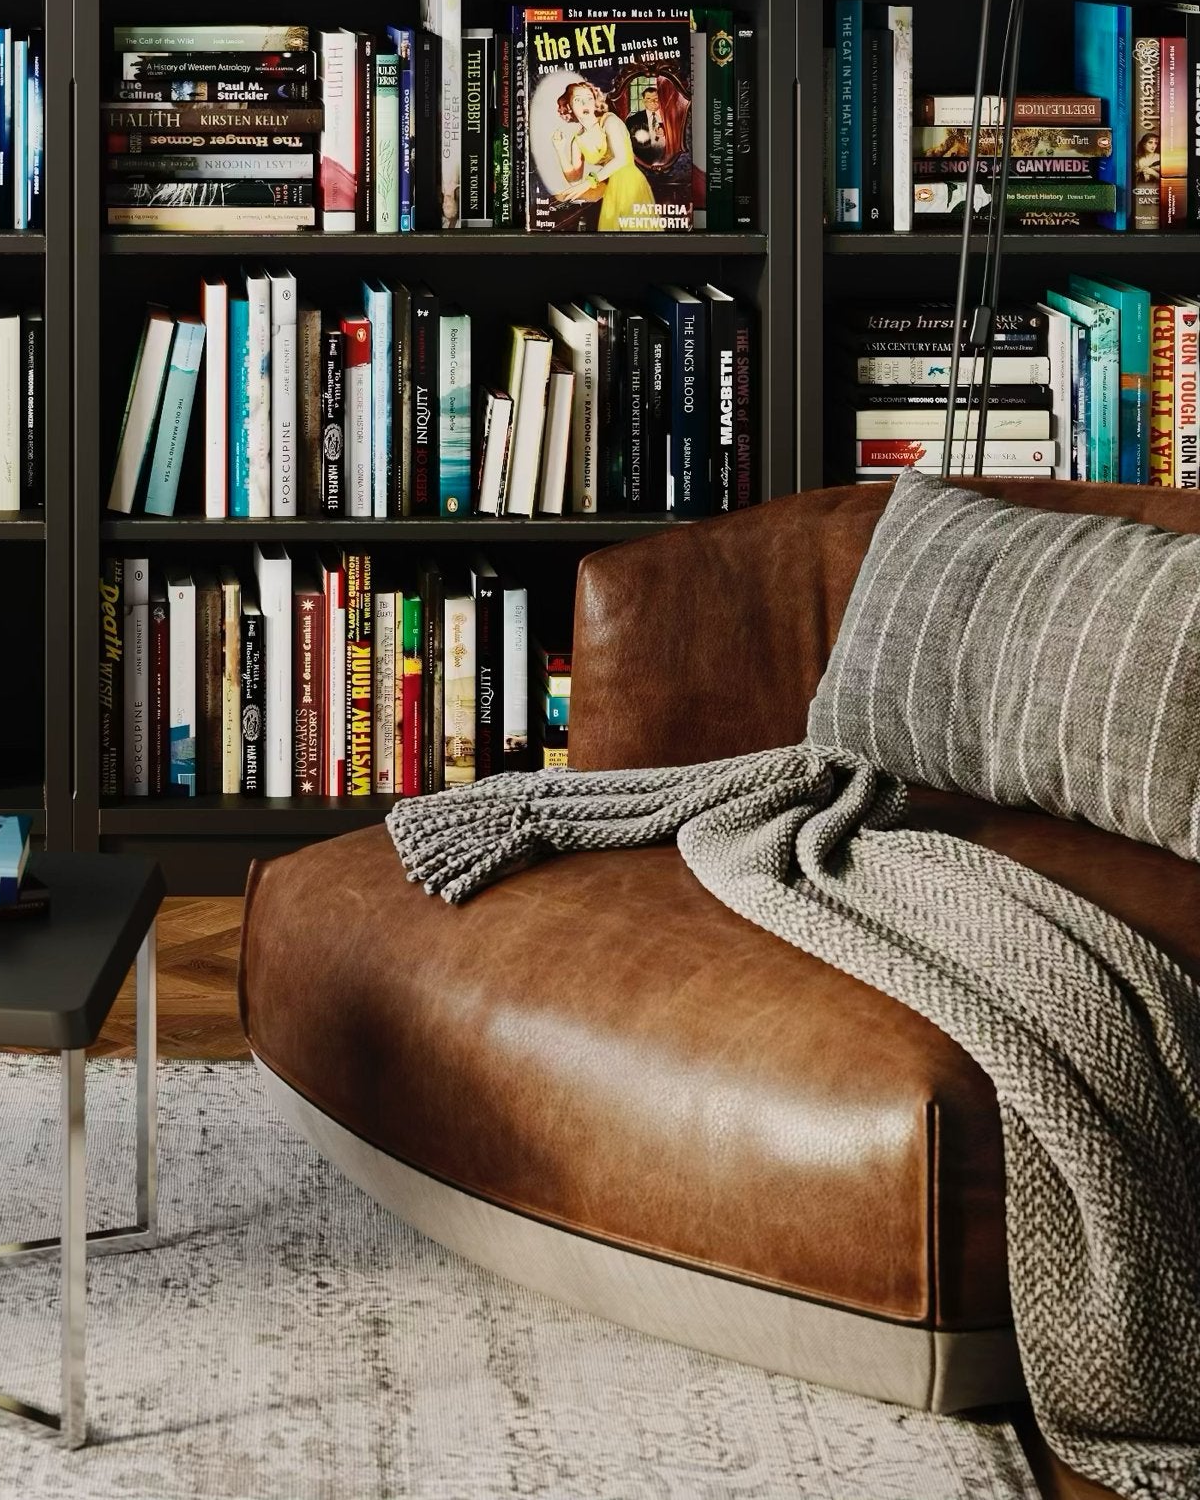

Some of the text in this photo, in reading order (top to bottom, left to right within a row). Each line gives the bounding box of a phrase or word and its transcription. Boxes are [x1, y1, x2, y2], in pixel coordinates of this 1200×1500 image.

[534, 24, 679, 62] the KEY unlocks the
[564, 62, 574, 72] to
[579, 56, 613, 70] murder
[617, 54, 635, 65] and
[641, 49, 681, 62] violence
[217, 82, 269, 100] Paul M. Strickler
[442, 78, 460, 159] GEORGETTE HEYER
[467, 50, 481, 134] THE HOBBIT
[1017, 104, 1096, 116] BEETLEJUICE
[150, 134, 303, 147] The Hunger Games
[201, 115, 289, 126] KIRSTEN KELLY
[710, 98, 724, 191] Title of your cover
[469, 154, 478, 210] J.R.R. TOLKIEN
[1016, 160, 1090, 173] GANYMEDE
[618, 203, 688, 229] PATRICIA WENTWORTH
[736, 328, 749, 352] THE
[867, 316, 911, 332] kitap
[684, 315, 695, 413] THE KING'S BLOOD
[736, 357, 749, 405] SNOWS
[1151, 305, 1175, 418] IT HARD
[416, 385, 430, 445] INIQUITY
[720, 350, 733, 445] MACBETH
[1179, 332, 1197, 464] RUN TOUGH, RUN
[282, 421, 291, 504] PORCUPINE
[327, 464, 339, 510] HARPER LEE
[416, 467, 427, 503] SEEDS
[737, 434, 750, 508] GANYMEDE
[98, 560, 123, 709] THE Death WISH
[514, 605, 525, 624] Gayle
[351, 646, 371, 796] MYSTERY BOOK
[480, 666, 494, 724] INIQUITY
[133, 701, 143, 784] PORCUPINE
[246, 745, 256, 790] HARPER LEE
[295, 708, 318, 778] HOGWARTS A HISTORY
